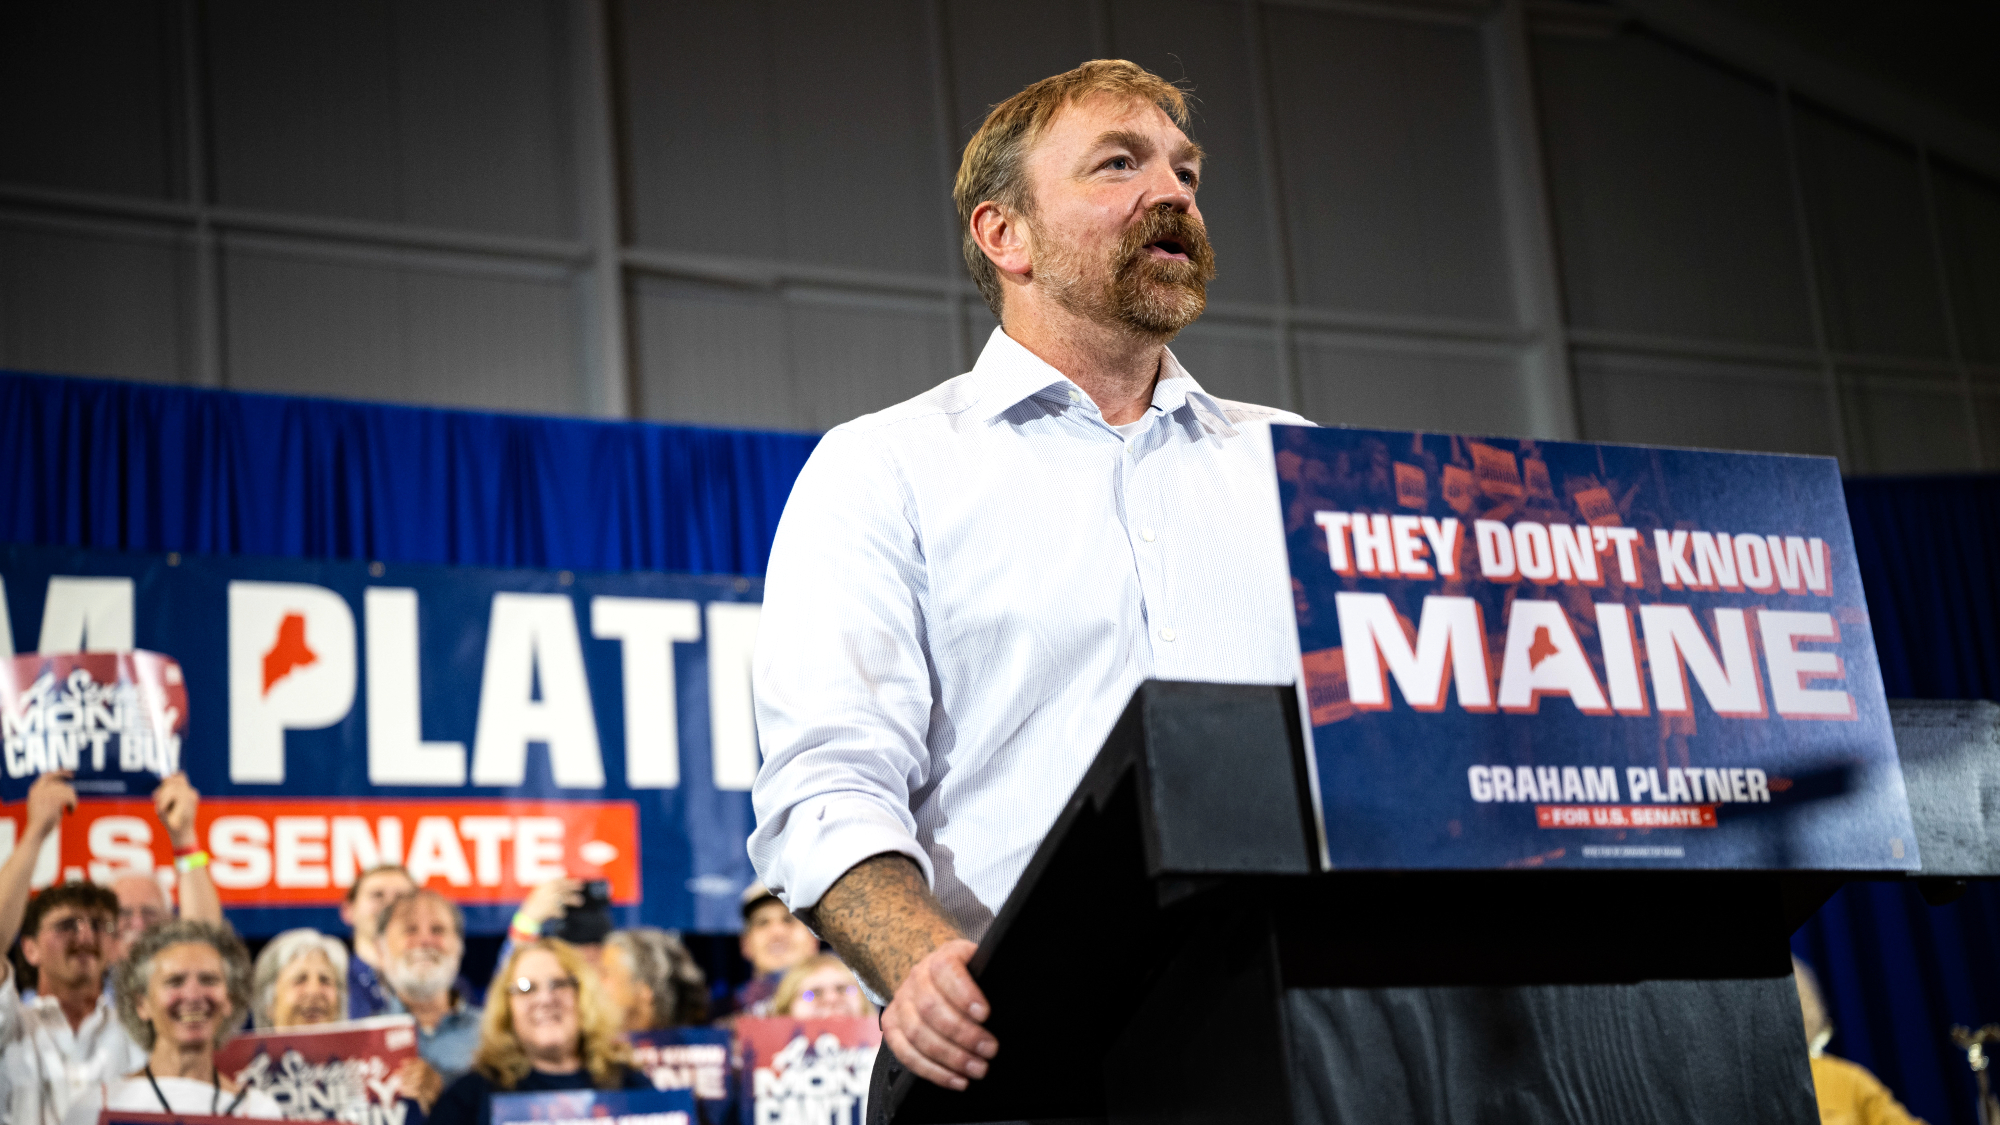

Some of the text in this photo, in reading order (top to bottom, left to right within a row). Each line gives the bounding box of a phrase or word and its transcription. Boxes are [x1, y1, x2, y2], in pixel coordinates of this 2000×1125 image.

[1315, 511, 1829, 595] THEY DON'T KNOW
[1334, 591, 1854, 716] MAINE
[4, 733, 111, 780] CAN'T
[1467, 765, 1770, 803] GRAHAM PLATNER
[1552, 808, 1702, 825] FOR U.S. SENATE
[208, 815, 567, 890] SENATE
